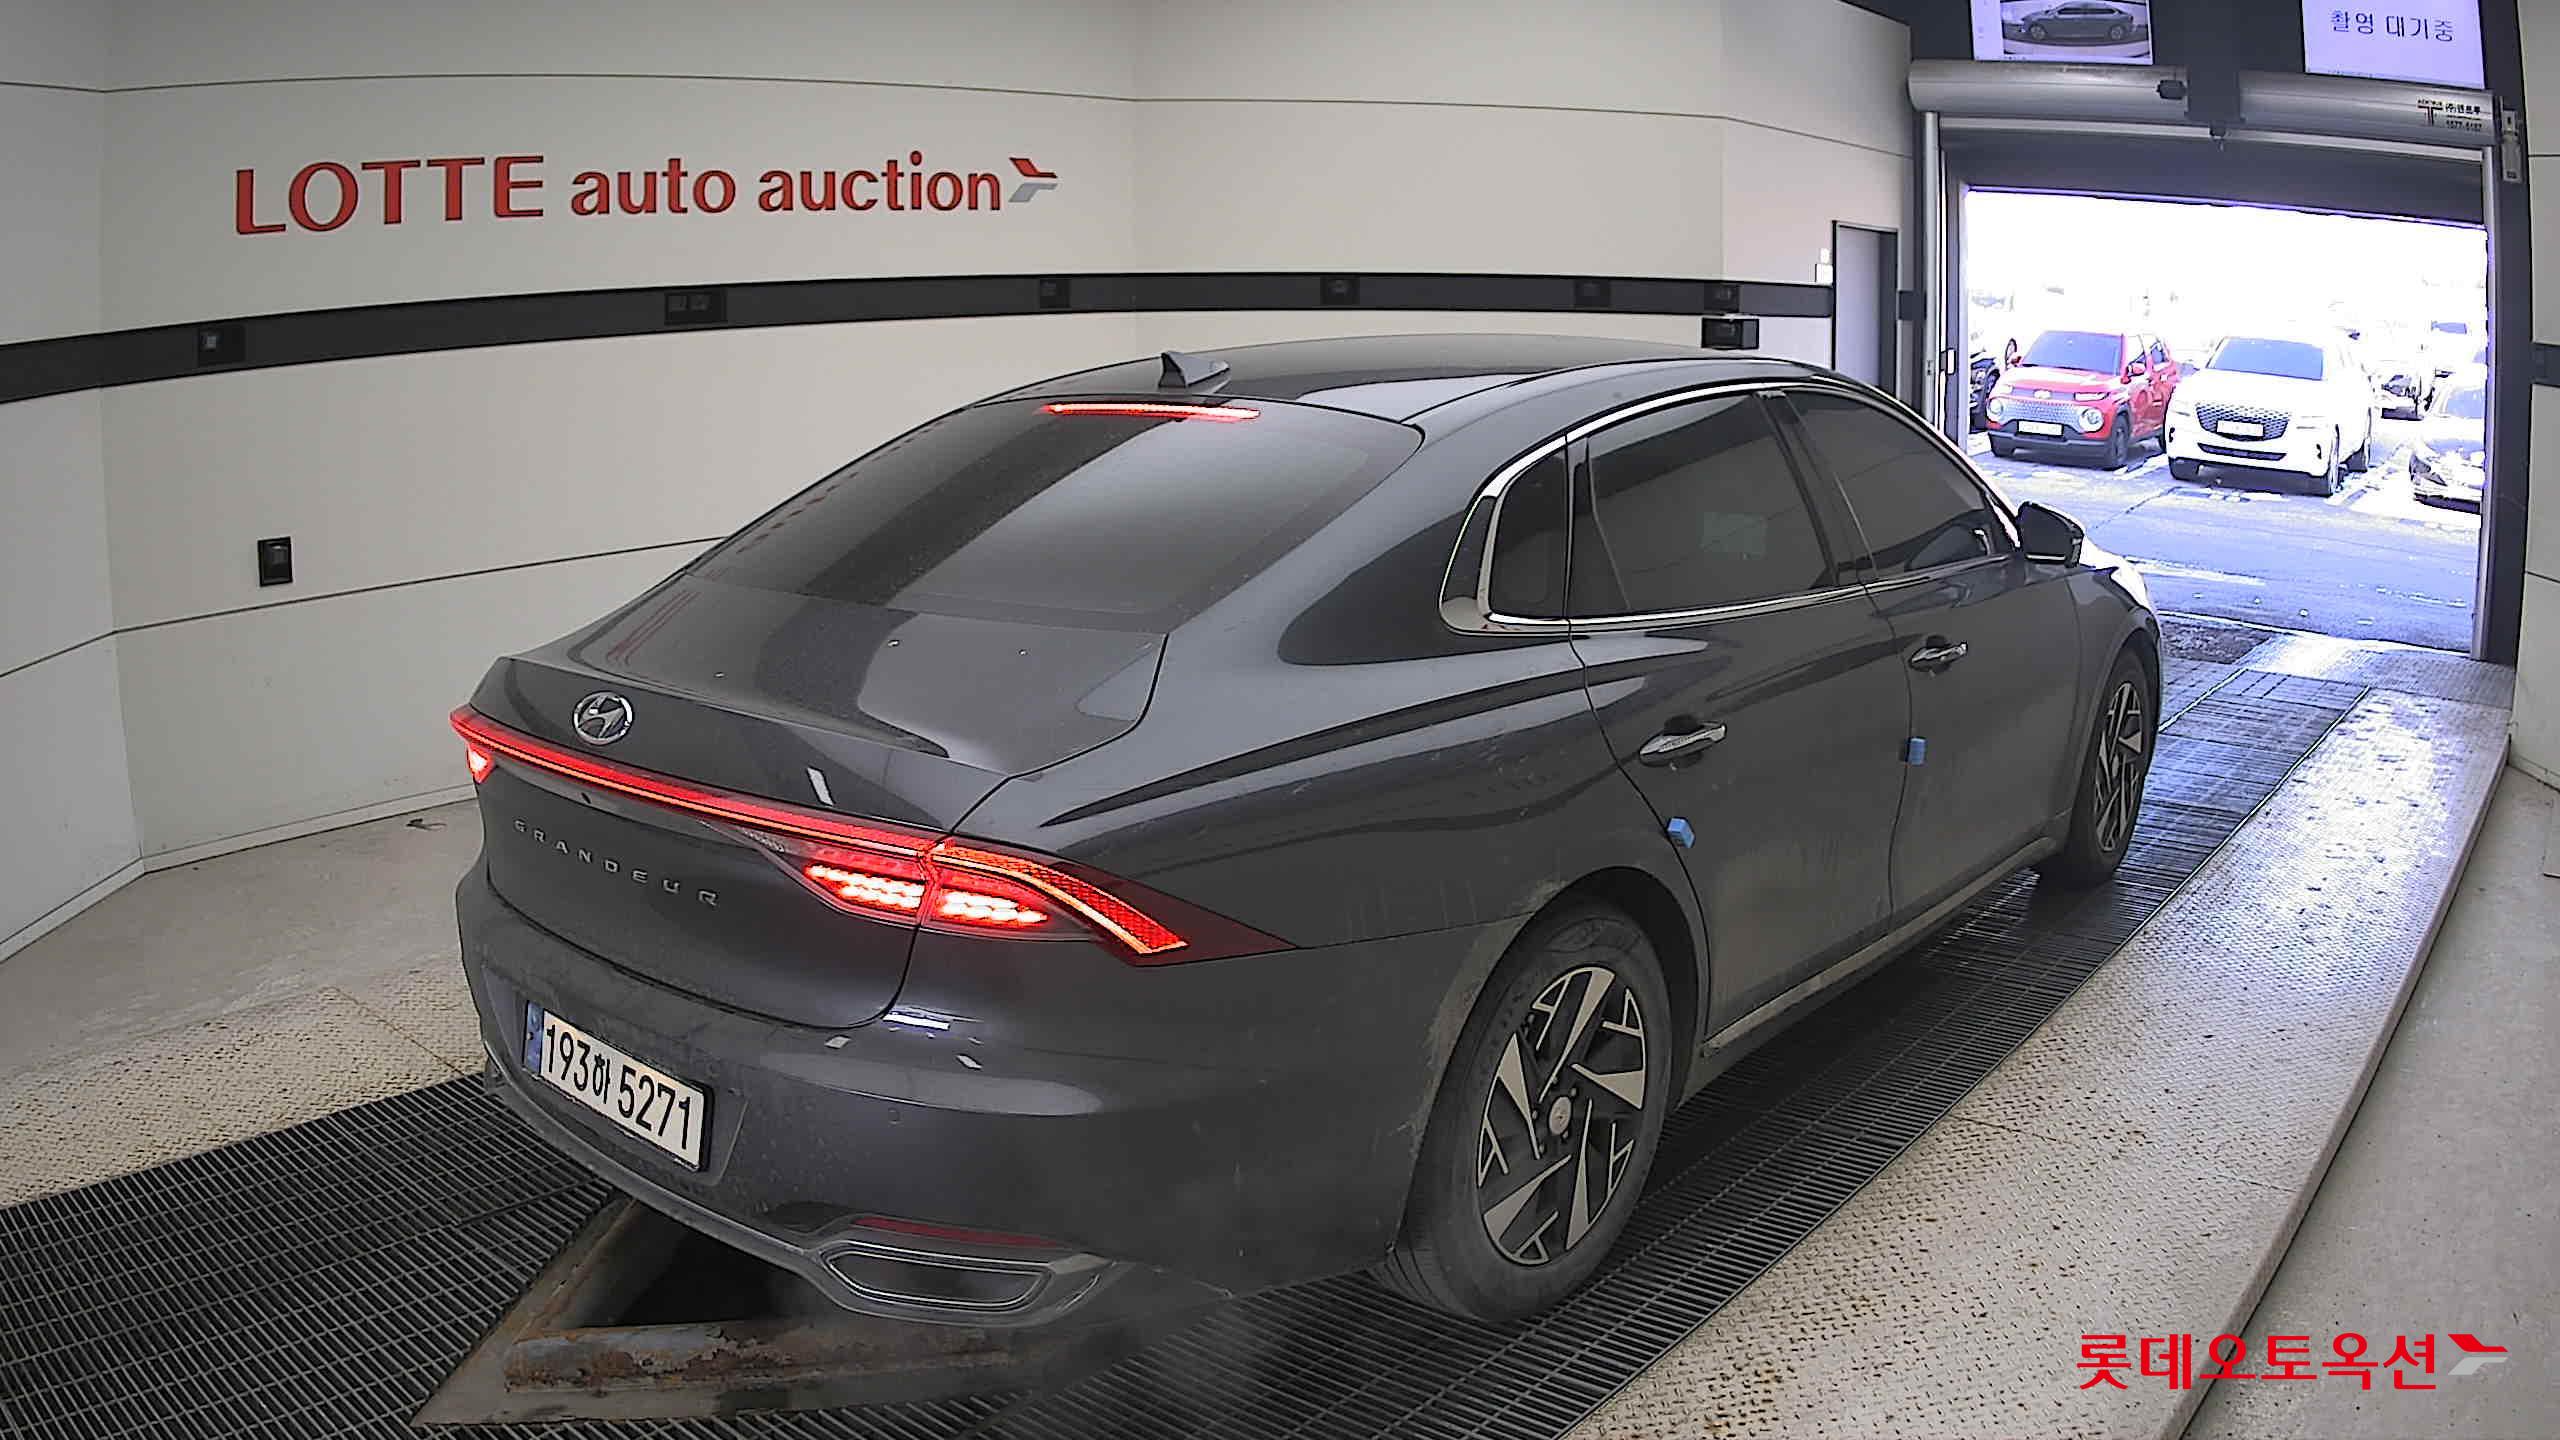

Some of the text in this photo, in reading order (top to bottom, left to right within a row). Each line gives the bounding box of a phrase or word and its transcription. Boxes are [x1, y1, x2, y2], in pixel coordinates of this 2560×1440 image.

[2331, 10, 2454, 42] 촬영 대기중
[234, 150, 1001, 235] LOTTE auto auction
[514, 819, 718, 906] GRANDEUR
[546, 1024, 692, 1150] 193하 5271
